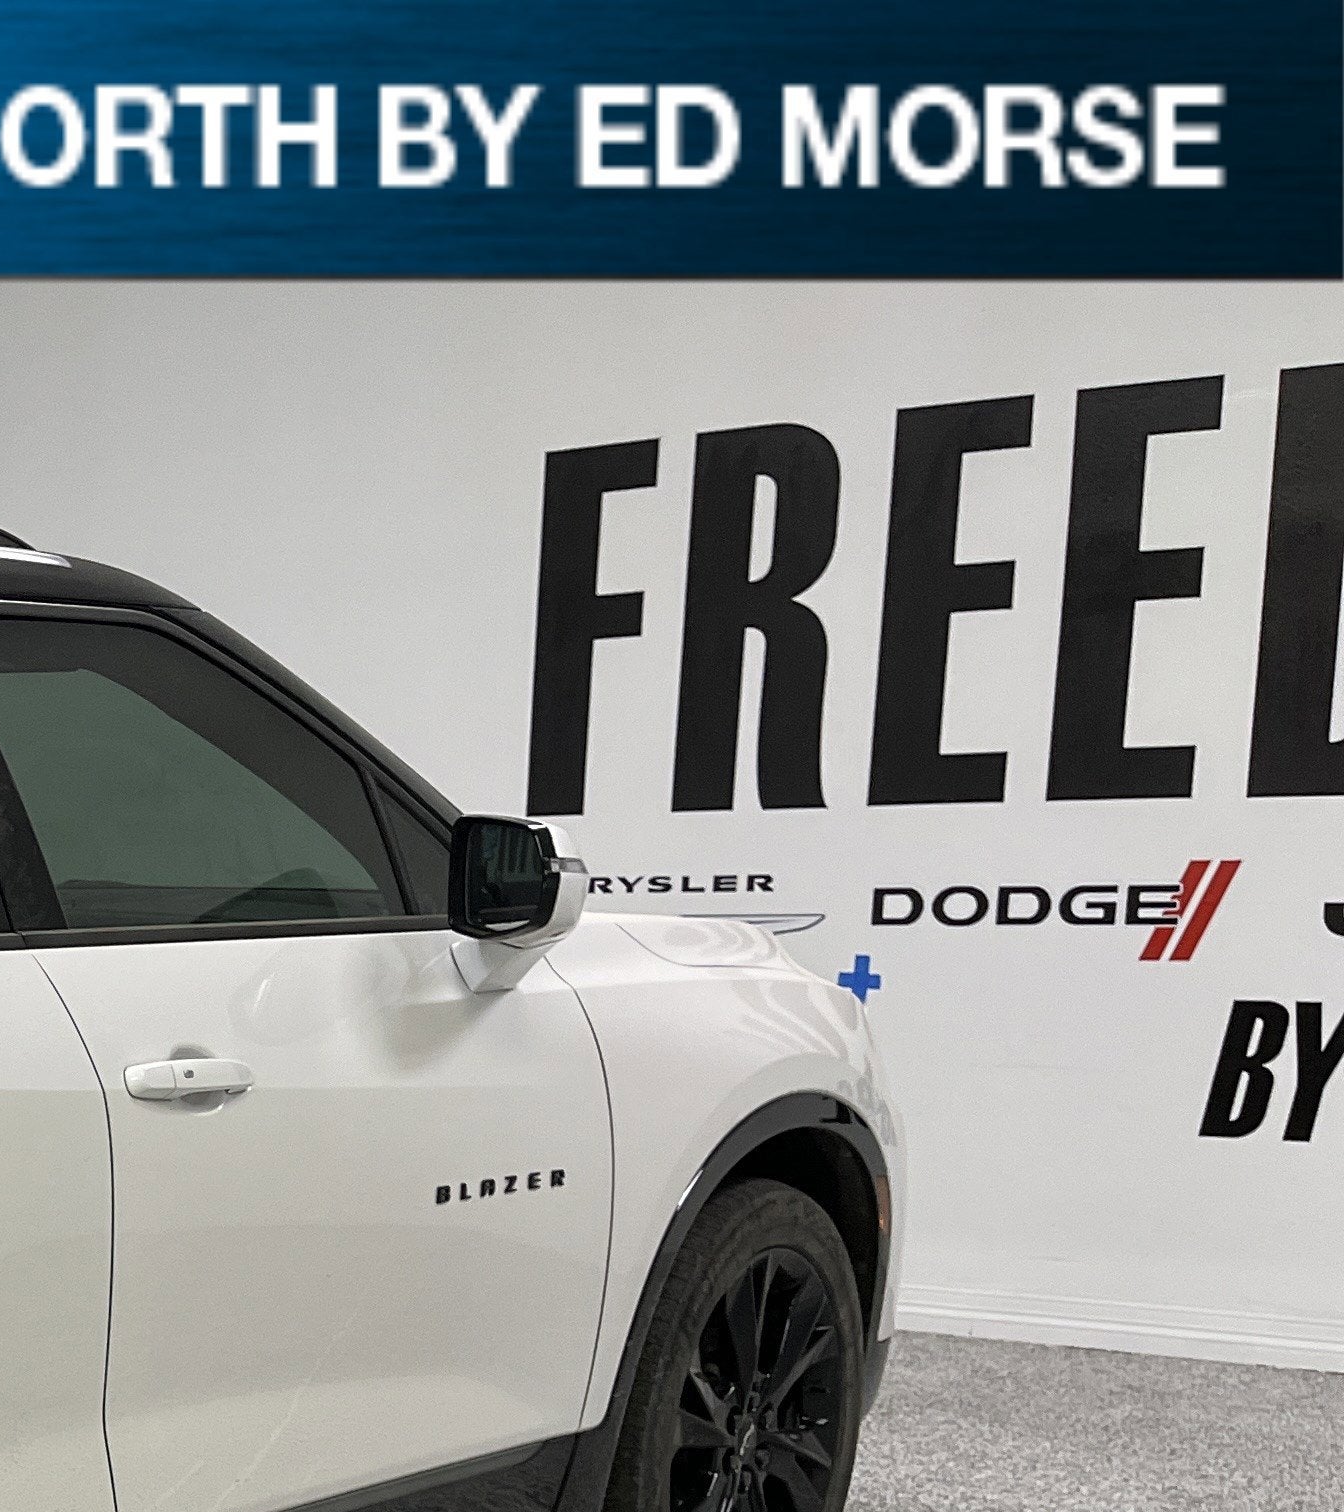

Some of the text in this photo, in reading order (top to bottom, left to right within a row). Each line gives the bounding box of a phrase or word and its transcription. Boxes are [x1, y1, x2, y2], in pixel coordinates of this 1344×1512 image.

[587, 873, 774, 895] RYSLER
[870, 884, 1182, 927] DODGE
[1198, 999, 1344, 1143] BY
[435, 1168, 566, 1205] BLAZER
